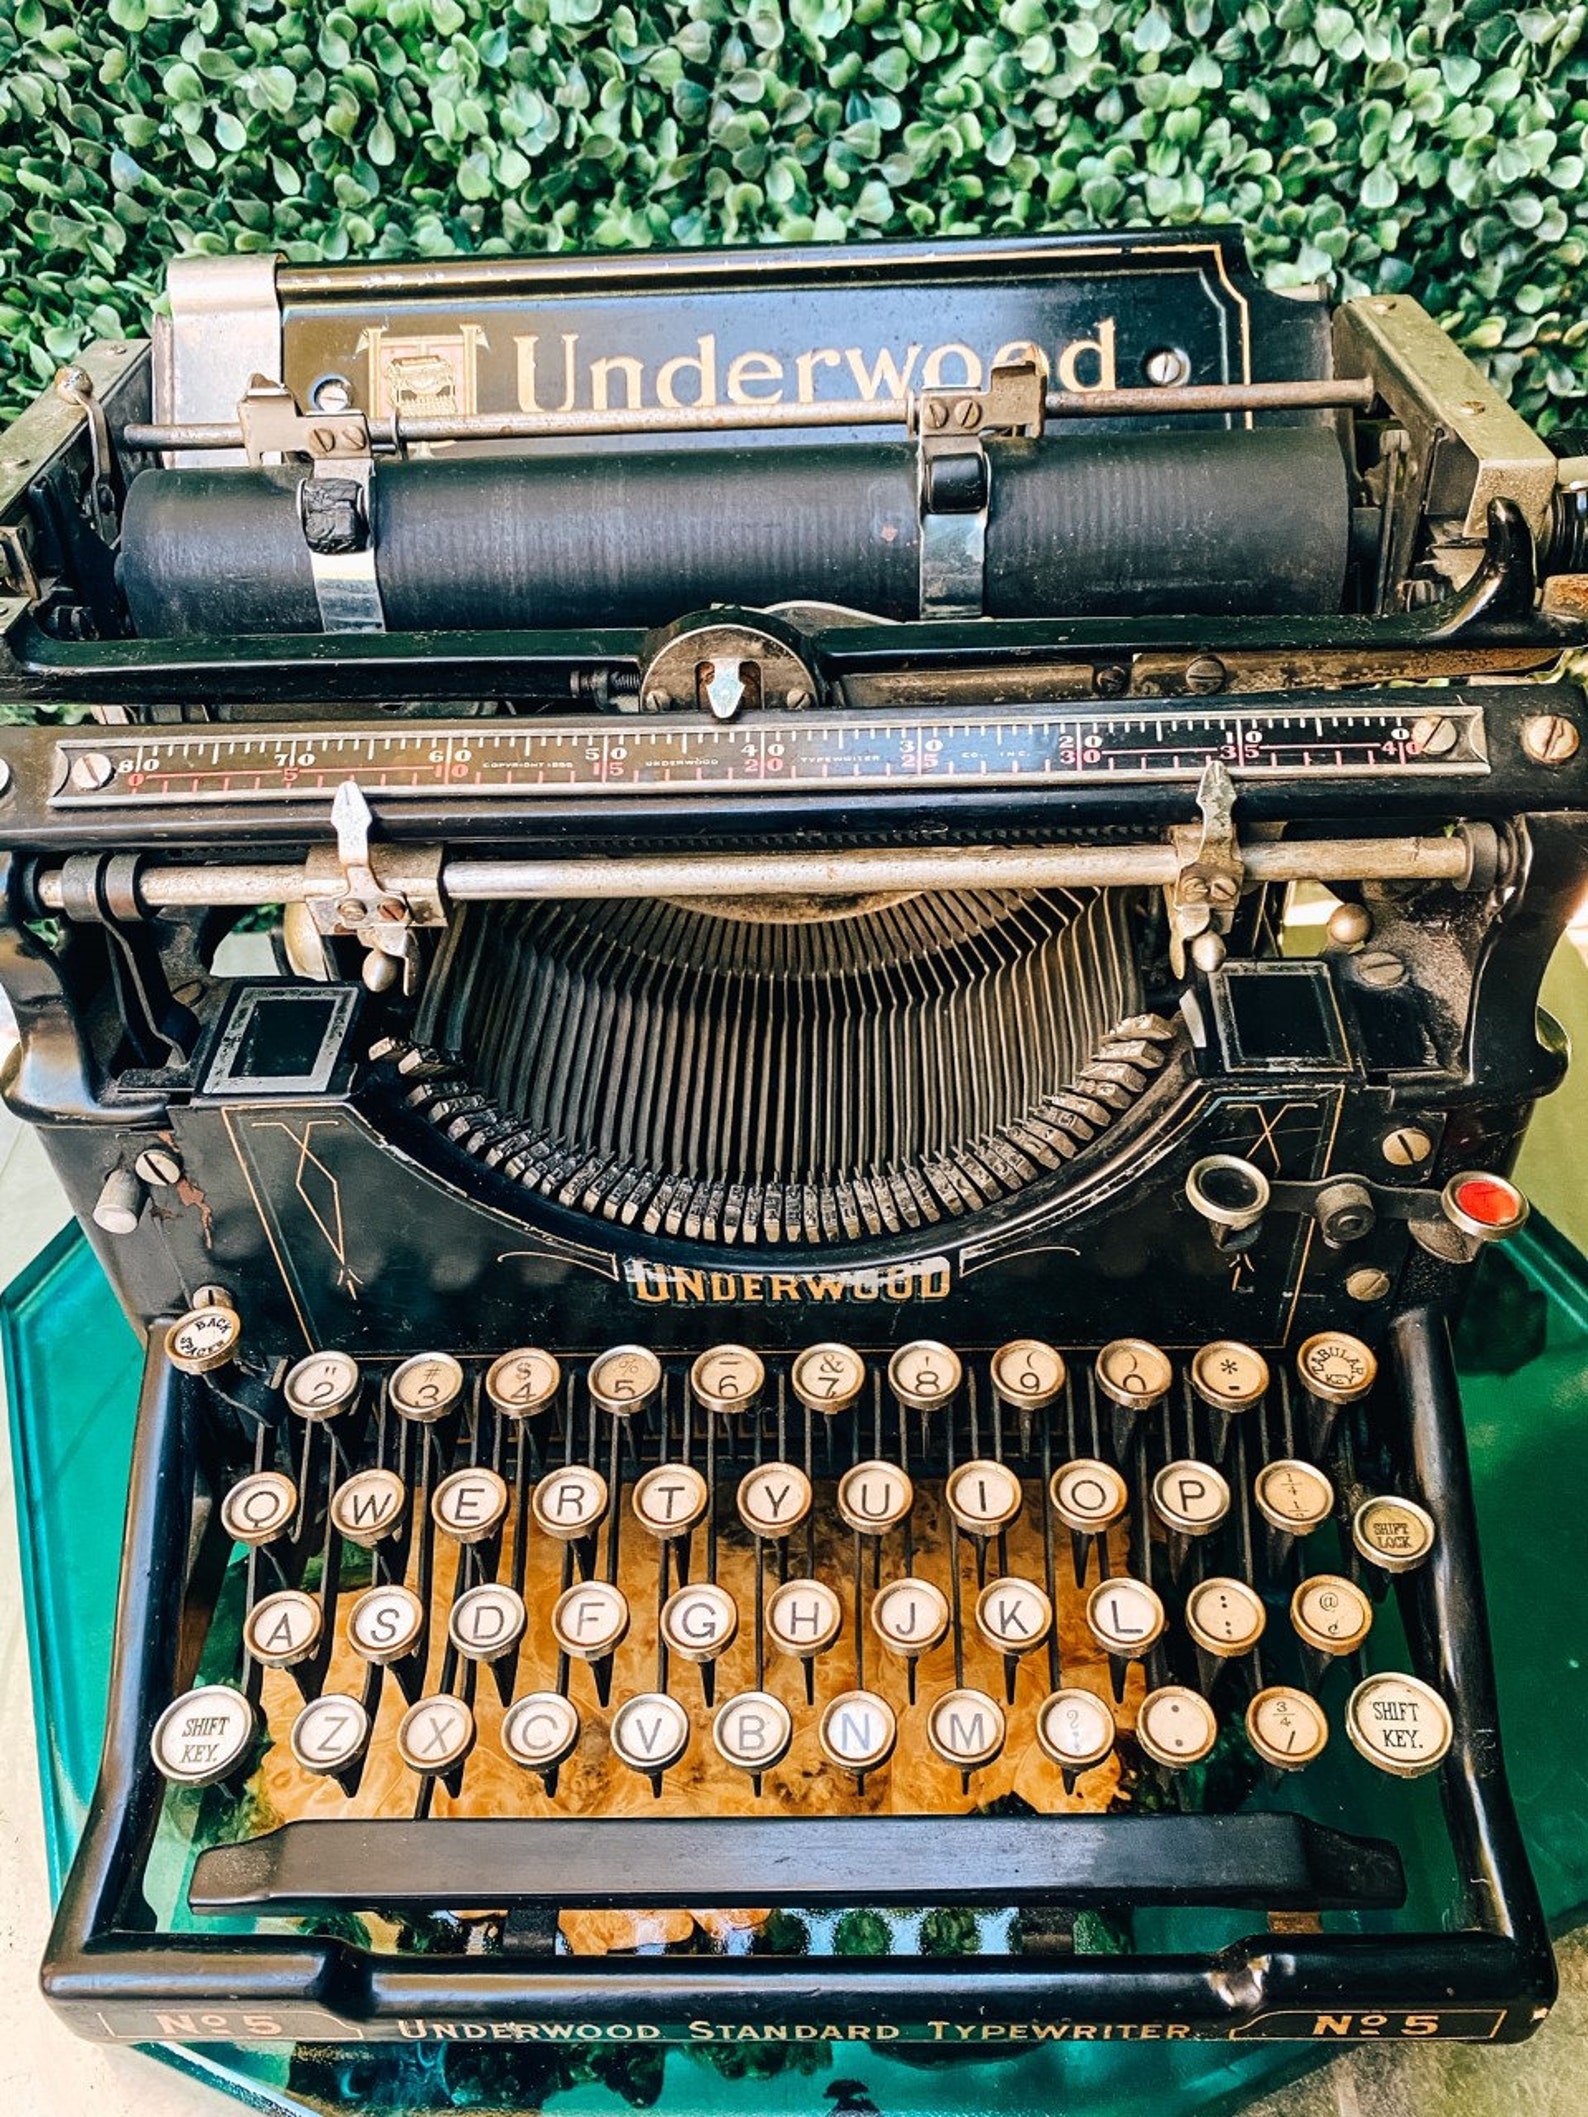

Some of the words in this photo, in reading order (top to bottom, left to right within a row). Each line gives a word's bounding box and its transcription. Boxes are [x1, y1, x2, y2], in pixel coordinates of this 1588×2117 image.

[118, 759, 160, 773] 80
[274, 753, 315, 767] 70
[429, 749, 472, 763] 60
[585, 747, 627, 761] 50
[741, 743, 785, 757] 40
[900, 739, 943, 753] 30
[1059, 735, 1102, 749] 20
[1391, 728, 1410, 740] 0
[283, 767, 299, 781] 5
[435, 764, 468, 778] 10
[593, 762, 624, 777] 15
[745, 758, 783, 772] 20
[901, 753, 939, 769] 25
[1060, 749, 1100, 763] 30
[1220, 744, 1260, 759] 35
[645, 758, 718, 767] UNDERWOOD
[195, 1317, 232, 1334] BACK
[1311, 1346, 1364, 1375] TABULAR
[309, 1381, 335, 1403] 2
[511, 1382, 536, 1400] 4
[718, 1375, 739, 1397] 6
[818, 1377, 839, 1397] 7
[915, 1371, 940, 1394] 8
[1020, 1372, 1040, 1392] 9
[243, 1491, 280, 1528] Q
[353, 1493, 393, 1525] W
[454, 1488, 485, 1520] E
[557, 1485, 586, 1517] R
[658, 1486, 685, 1519] T
[764, 1485, 791, 1518] Y
[861, 1484, 890, 1516] U
[979, 1480, 987, 1513] I
[1071, 1479, 1107, 1511] O
[1178, 1480, 1206, 1512] P
[1373, 1523, 1408, 1535] SHIFT
[1377, 1537, 1412, 1548] LOCK
[265, 1612, 293, 1647] A
[371, 1608, 400, 1642] S
[472, 1606, 505, 1639] D
[577, 1602, 605, 1637] F
[682, 1602, 716, 1638] G
[790, 1602, 819, 1635] H
[896, 1602, 915, 1635] J
[999, 1600, 1028, 1634] K
[1111, 1600, 1143, 1634] L
[182, 1716, 230, 1737] SHIFT
[1373, 1702, 1419, 1722] SHIFT
[317, 1716, 350, 1752] Z
[421, 1717, 456, 1754] X
[522, 1715, 558, 1750] C
[636, 1717, 662, 1754] V
[738, 1715, 765, 1750] B
[841, 1713, 870, 1751] N
[950, 1713, 985, 1751] M
[1383, 1729, 1424, 1749] KEY.
[179, 1744, 218, 1763] KEY.
[244, 2014, 283, 2036] 5
[398, 2018, 662, 2040] UNDERWOOD
[689, 2020, 899, 2040] STANDARD
[928, 2020, 1191, 2040] TYPEWRITER
[1401, 2014, 1441, 2036] 5
